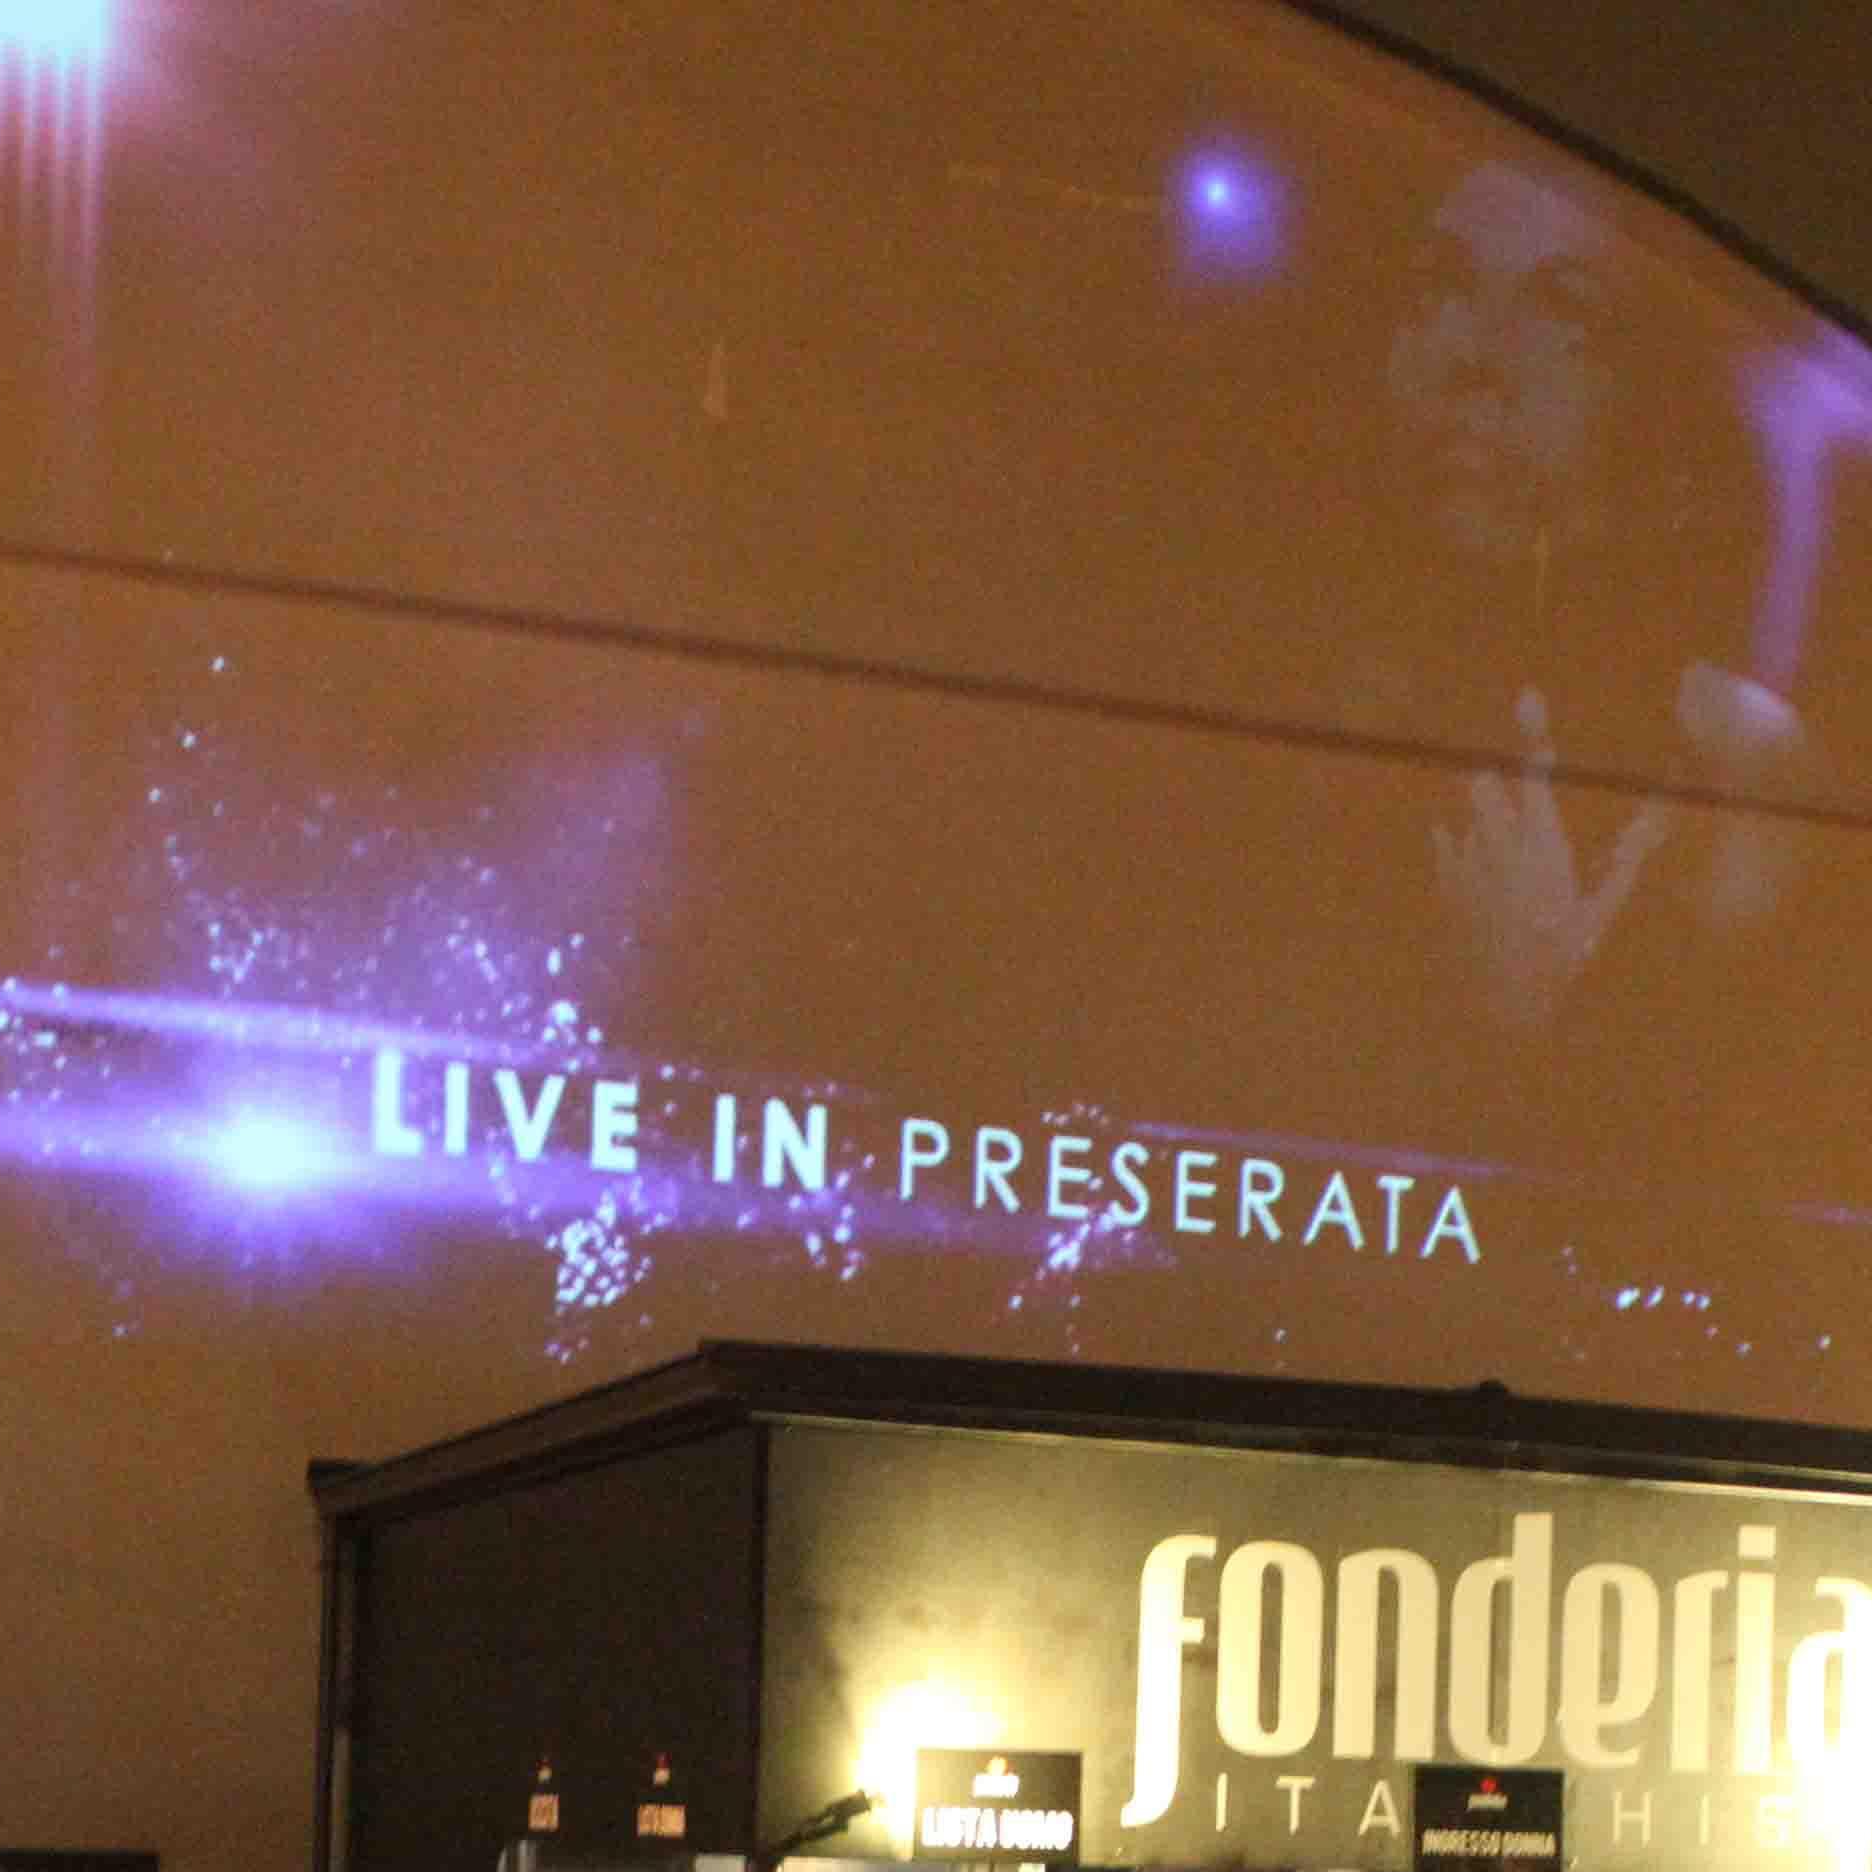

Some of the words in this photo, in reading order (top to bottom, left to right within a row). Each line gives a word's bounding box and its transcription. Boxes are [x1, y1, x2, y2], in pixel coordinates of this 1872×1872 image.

[372, 1047, 641, 1173] LIVE
[712, 1095, 829, 1193] IN
[898, 1120, 1481, 1266] PRESERATA
[922, 1806, 997, 1848] LISTA
[1422, 1828, 1501, 1857] INGRESSO
